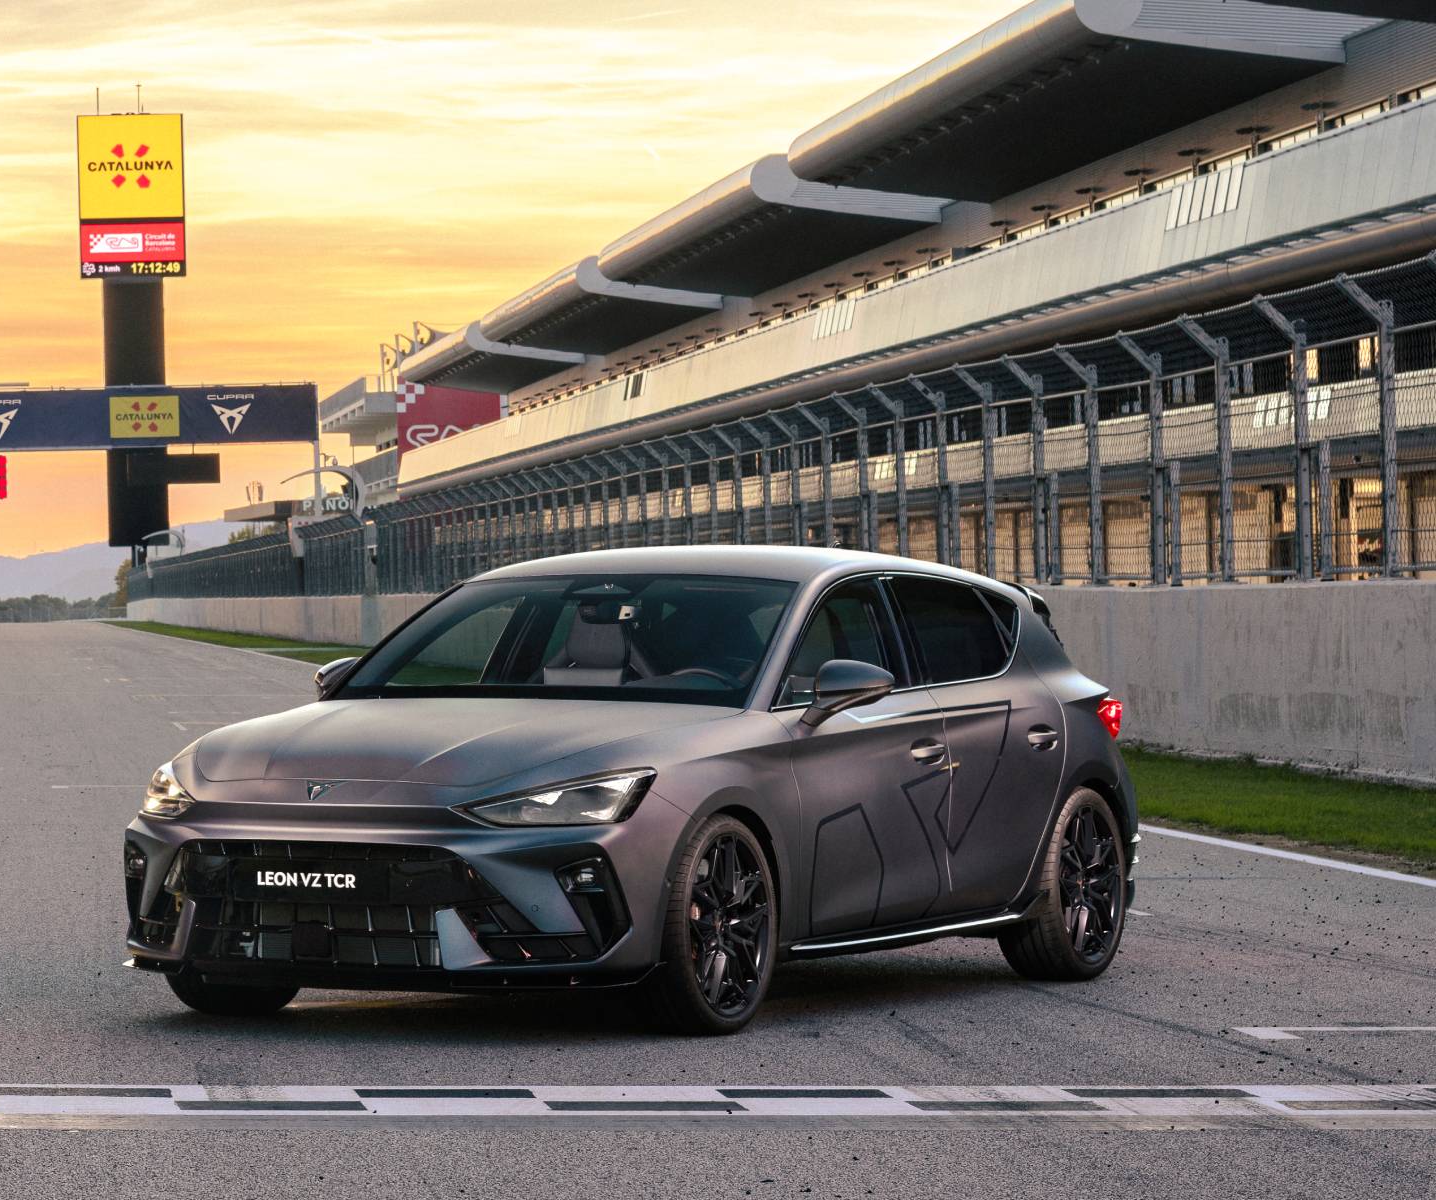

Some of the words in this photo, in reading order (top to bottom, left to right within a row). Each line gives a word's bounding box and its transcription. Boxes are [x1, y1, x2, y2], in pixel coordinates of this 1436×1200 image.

[87, 160, 173, 172] CATALUNYA
[104, 265, 121, 273] kmh
[131, 262, 181, 274] 17:12:49
[115, 412, 174, 421] CATALUNYA
[256, 871, 298, 887] LEON
[299, 872, 322, 888] VZ
[324, 873, 356, 889] TCR
